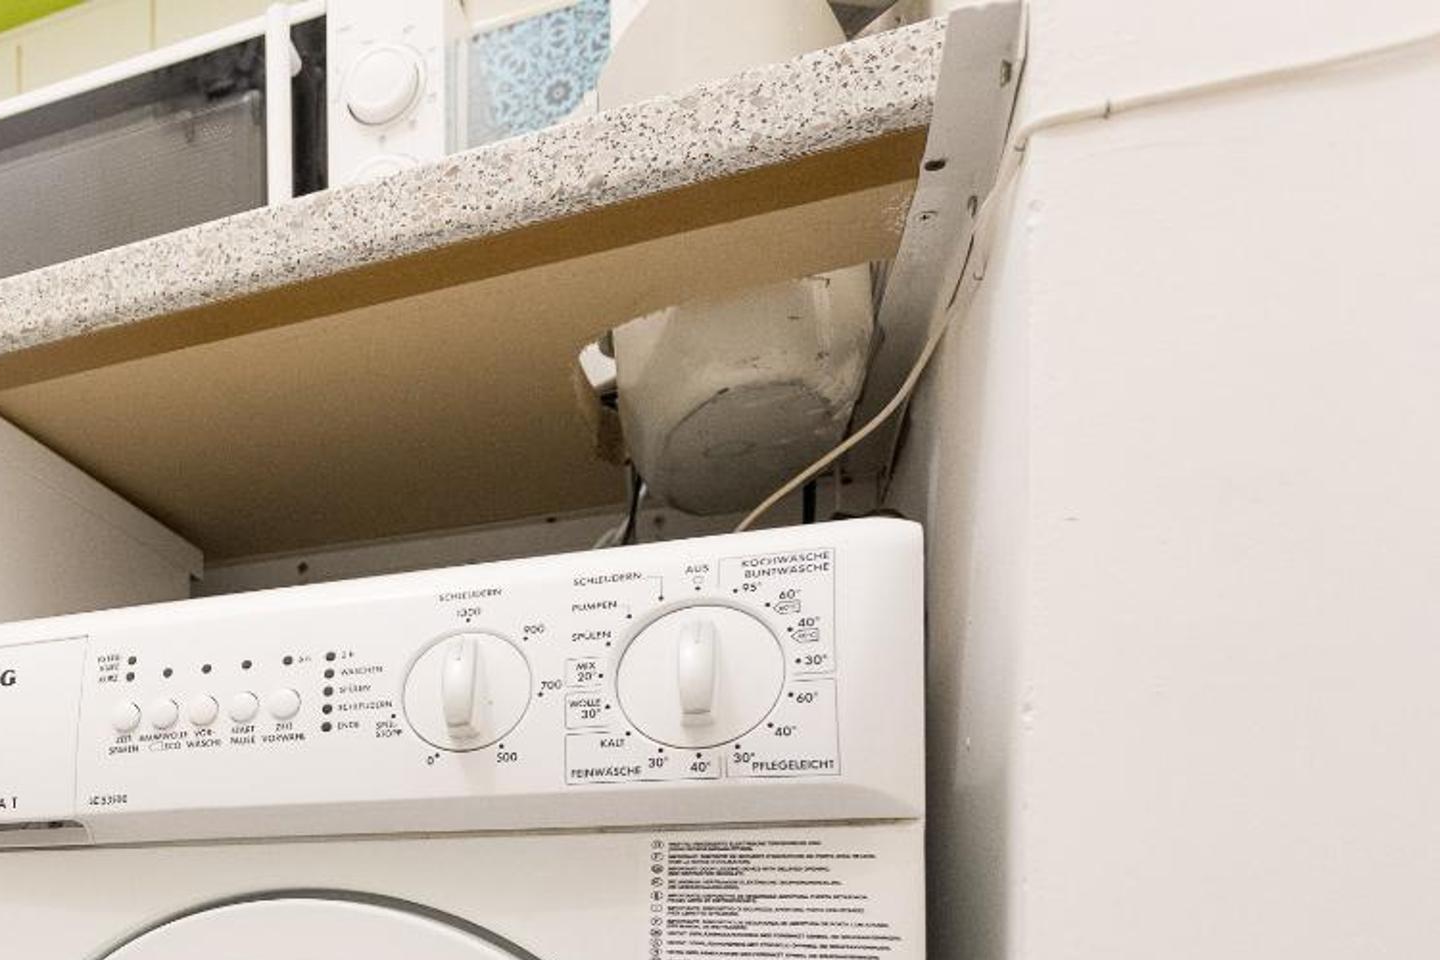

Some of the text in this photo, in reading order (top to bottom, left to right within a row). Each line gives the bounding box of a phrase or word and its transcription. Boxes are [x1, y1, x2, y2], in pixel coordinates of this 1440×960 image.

[684, 564, 710, 574] AUS
[779, 589, 801, 600] 60°
[572, 600, 618, 613] PUMPEN
[798, 616, 820, 627] 40°
[523, 624, 545, 635] 900
[804, 654, 828, 666] 30°
[576, 662, 597, 671] MIX
[541, 680, 562, 690] 700
[796, 691, 819, 704] 60°
[774, 725, 797, 737] 40°
[600, 738, 625, 749] KALT
[497, 752, 518, 764] 500
[648, 757, 669, 769] 30°
[733, 752, 756, 764] 30°
[690, 761, 712, 773] 40°
[752, 760, 835, 772] PFLEGELEICHT
